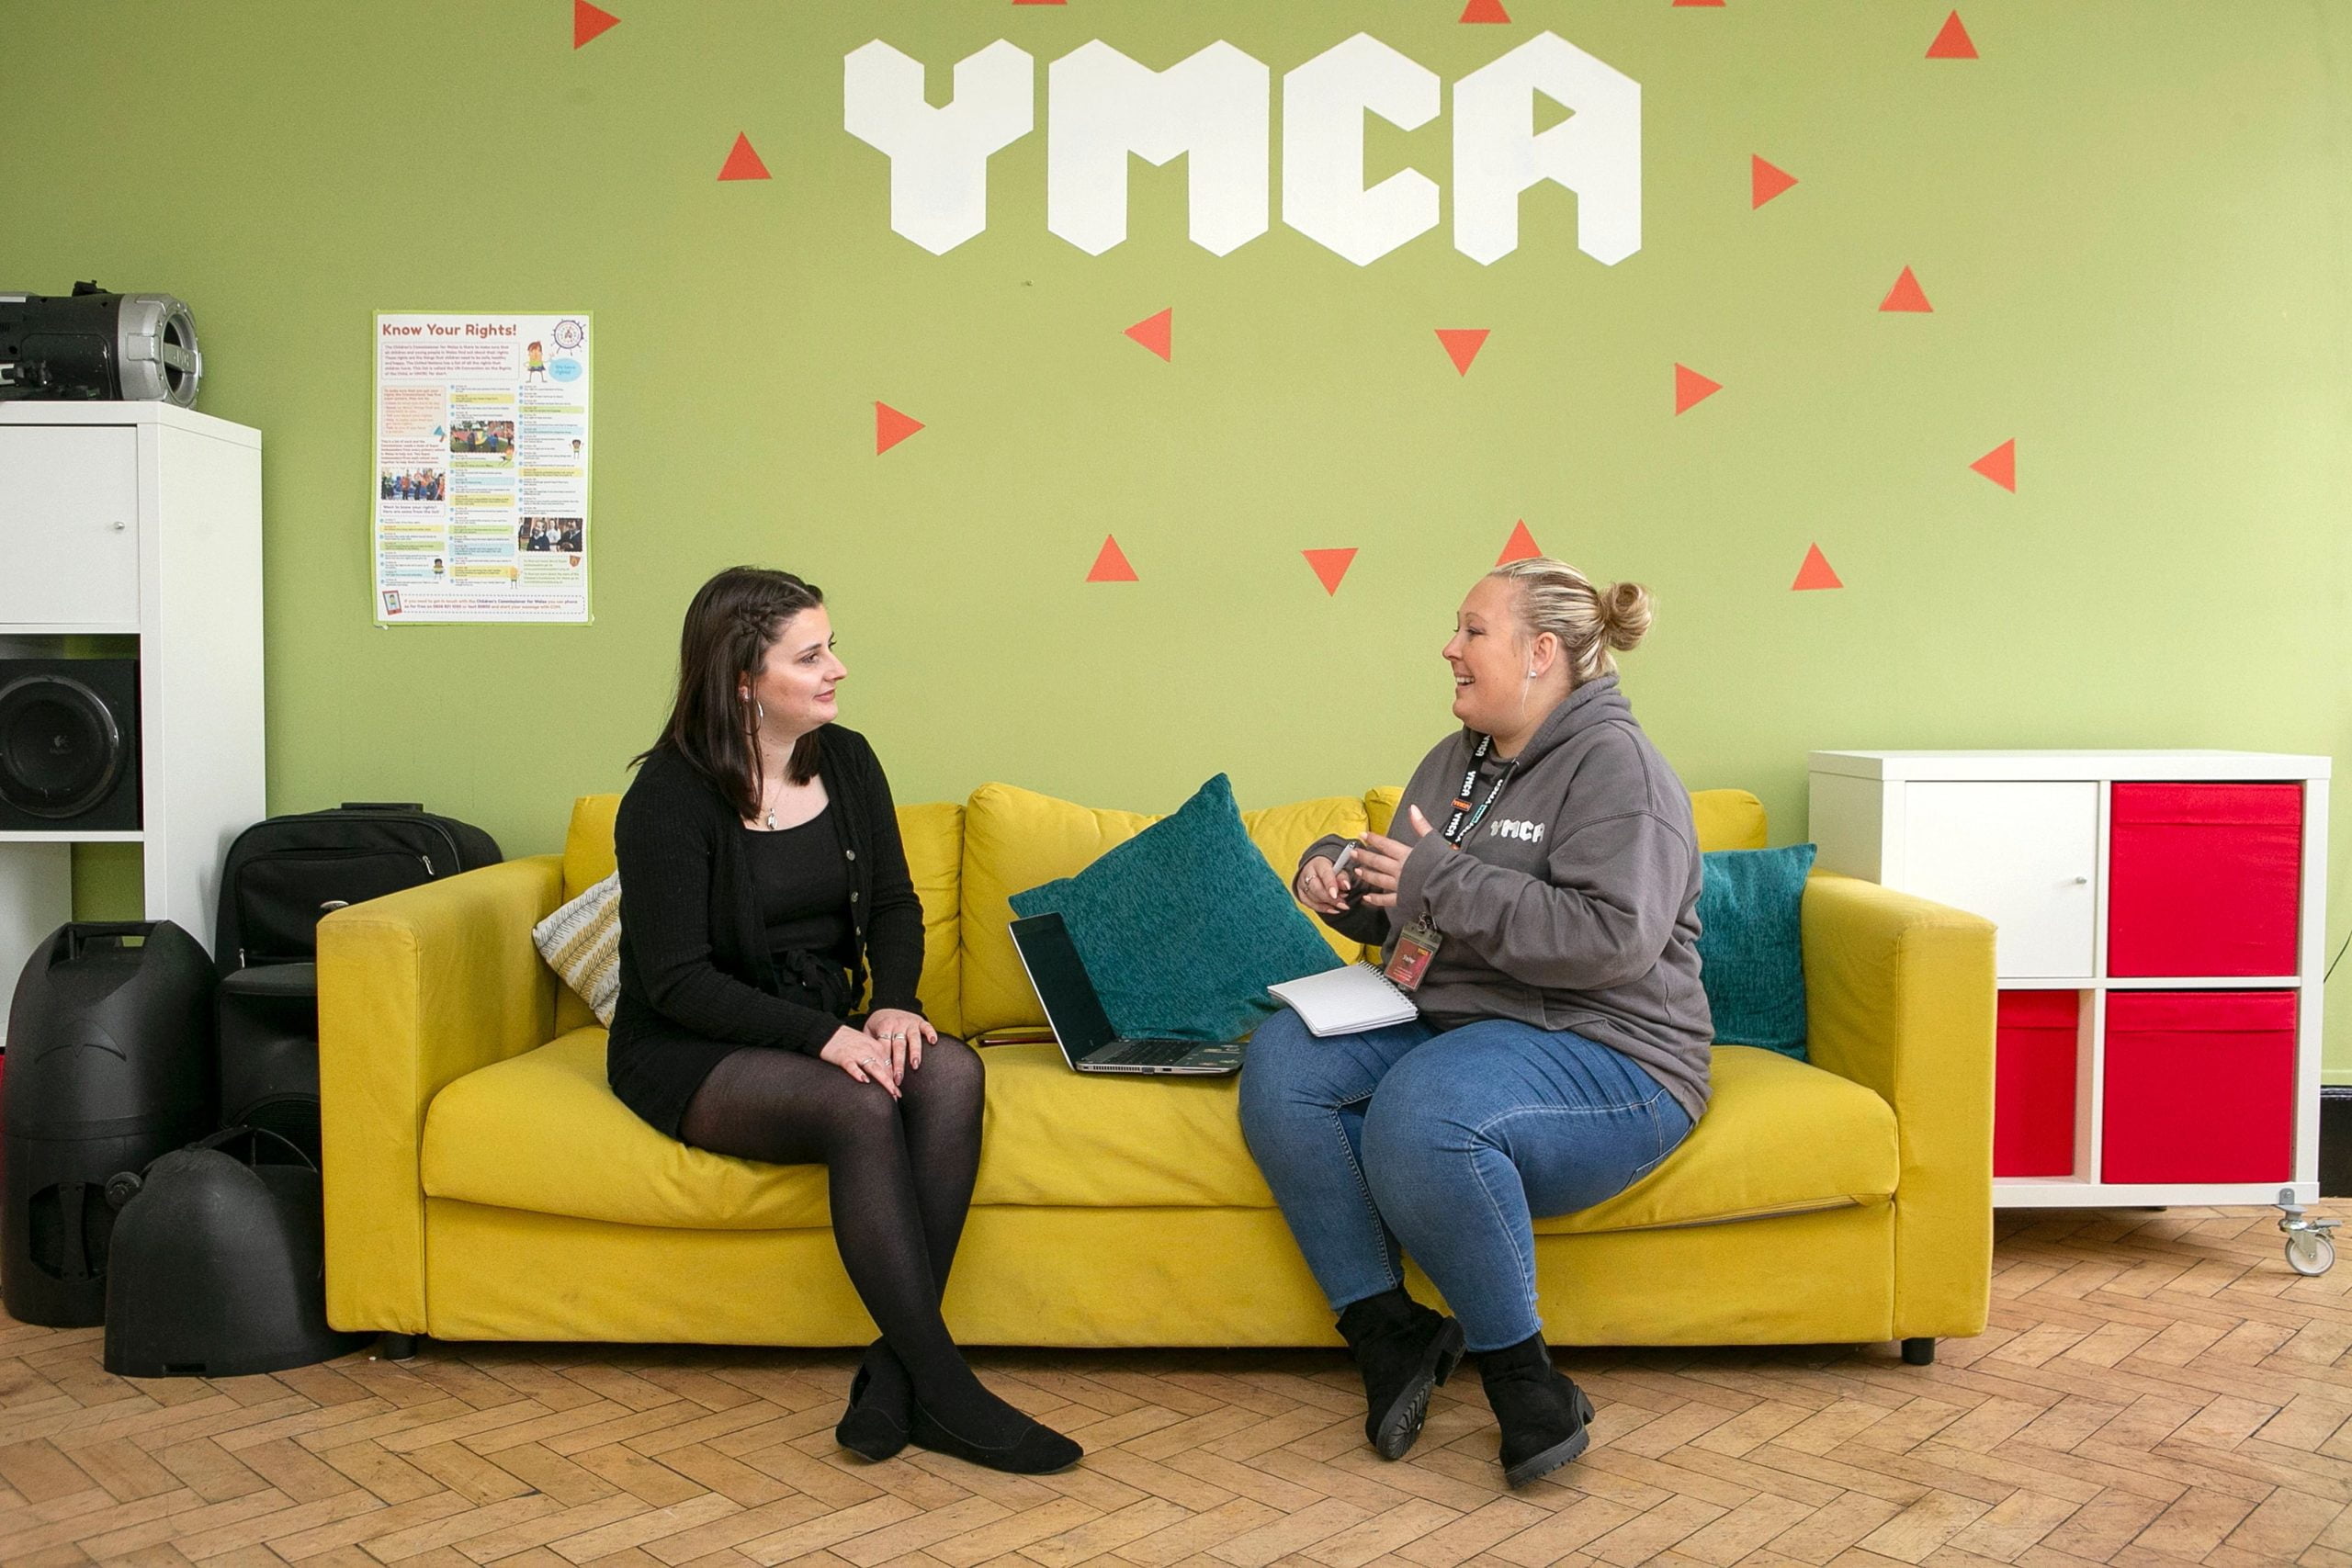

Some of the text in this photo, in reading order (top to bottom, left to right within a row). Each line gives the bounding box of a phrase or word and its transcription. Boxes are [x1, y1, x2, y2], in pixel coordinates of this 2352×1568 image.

[843, 29, 1642, 267] YMCA
[382, 323, 517, 339] Know Your Rights!
[1461, 771, 1476, 796] YMCA
[1485, 779, 1503, 805] YMCA
[1445, 812, 1463, 837] YMCA
[1490, 818, 1545, 843] YMCA
